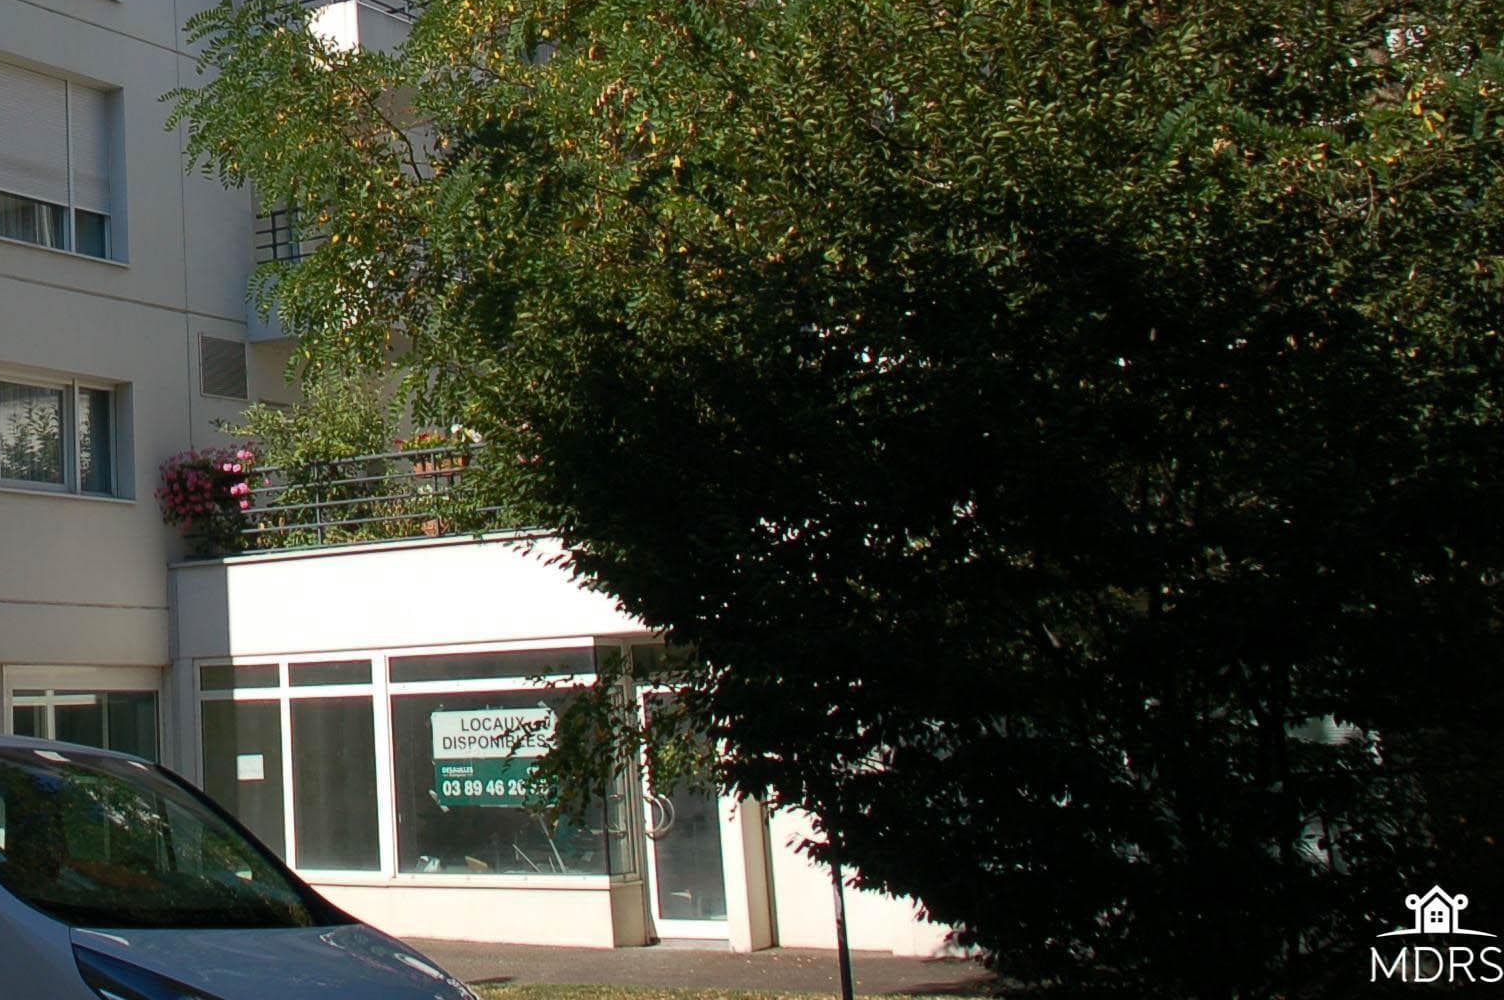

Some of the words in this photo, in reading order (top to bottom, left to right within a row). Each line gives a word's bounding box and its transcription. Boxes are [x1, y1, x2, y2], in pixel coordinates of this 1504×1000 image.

[461, 717, 524, 732] LOCAUX
[442, 780, 461, 796] 03
[464, 780, 483, 796] 89
[486, 780, 505, 796] 46
